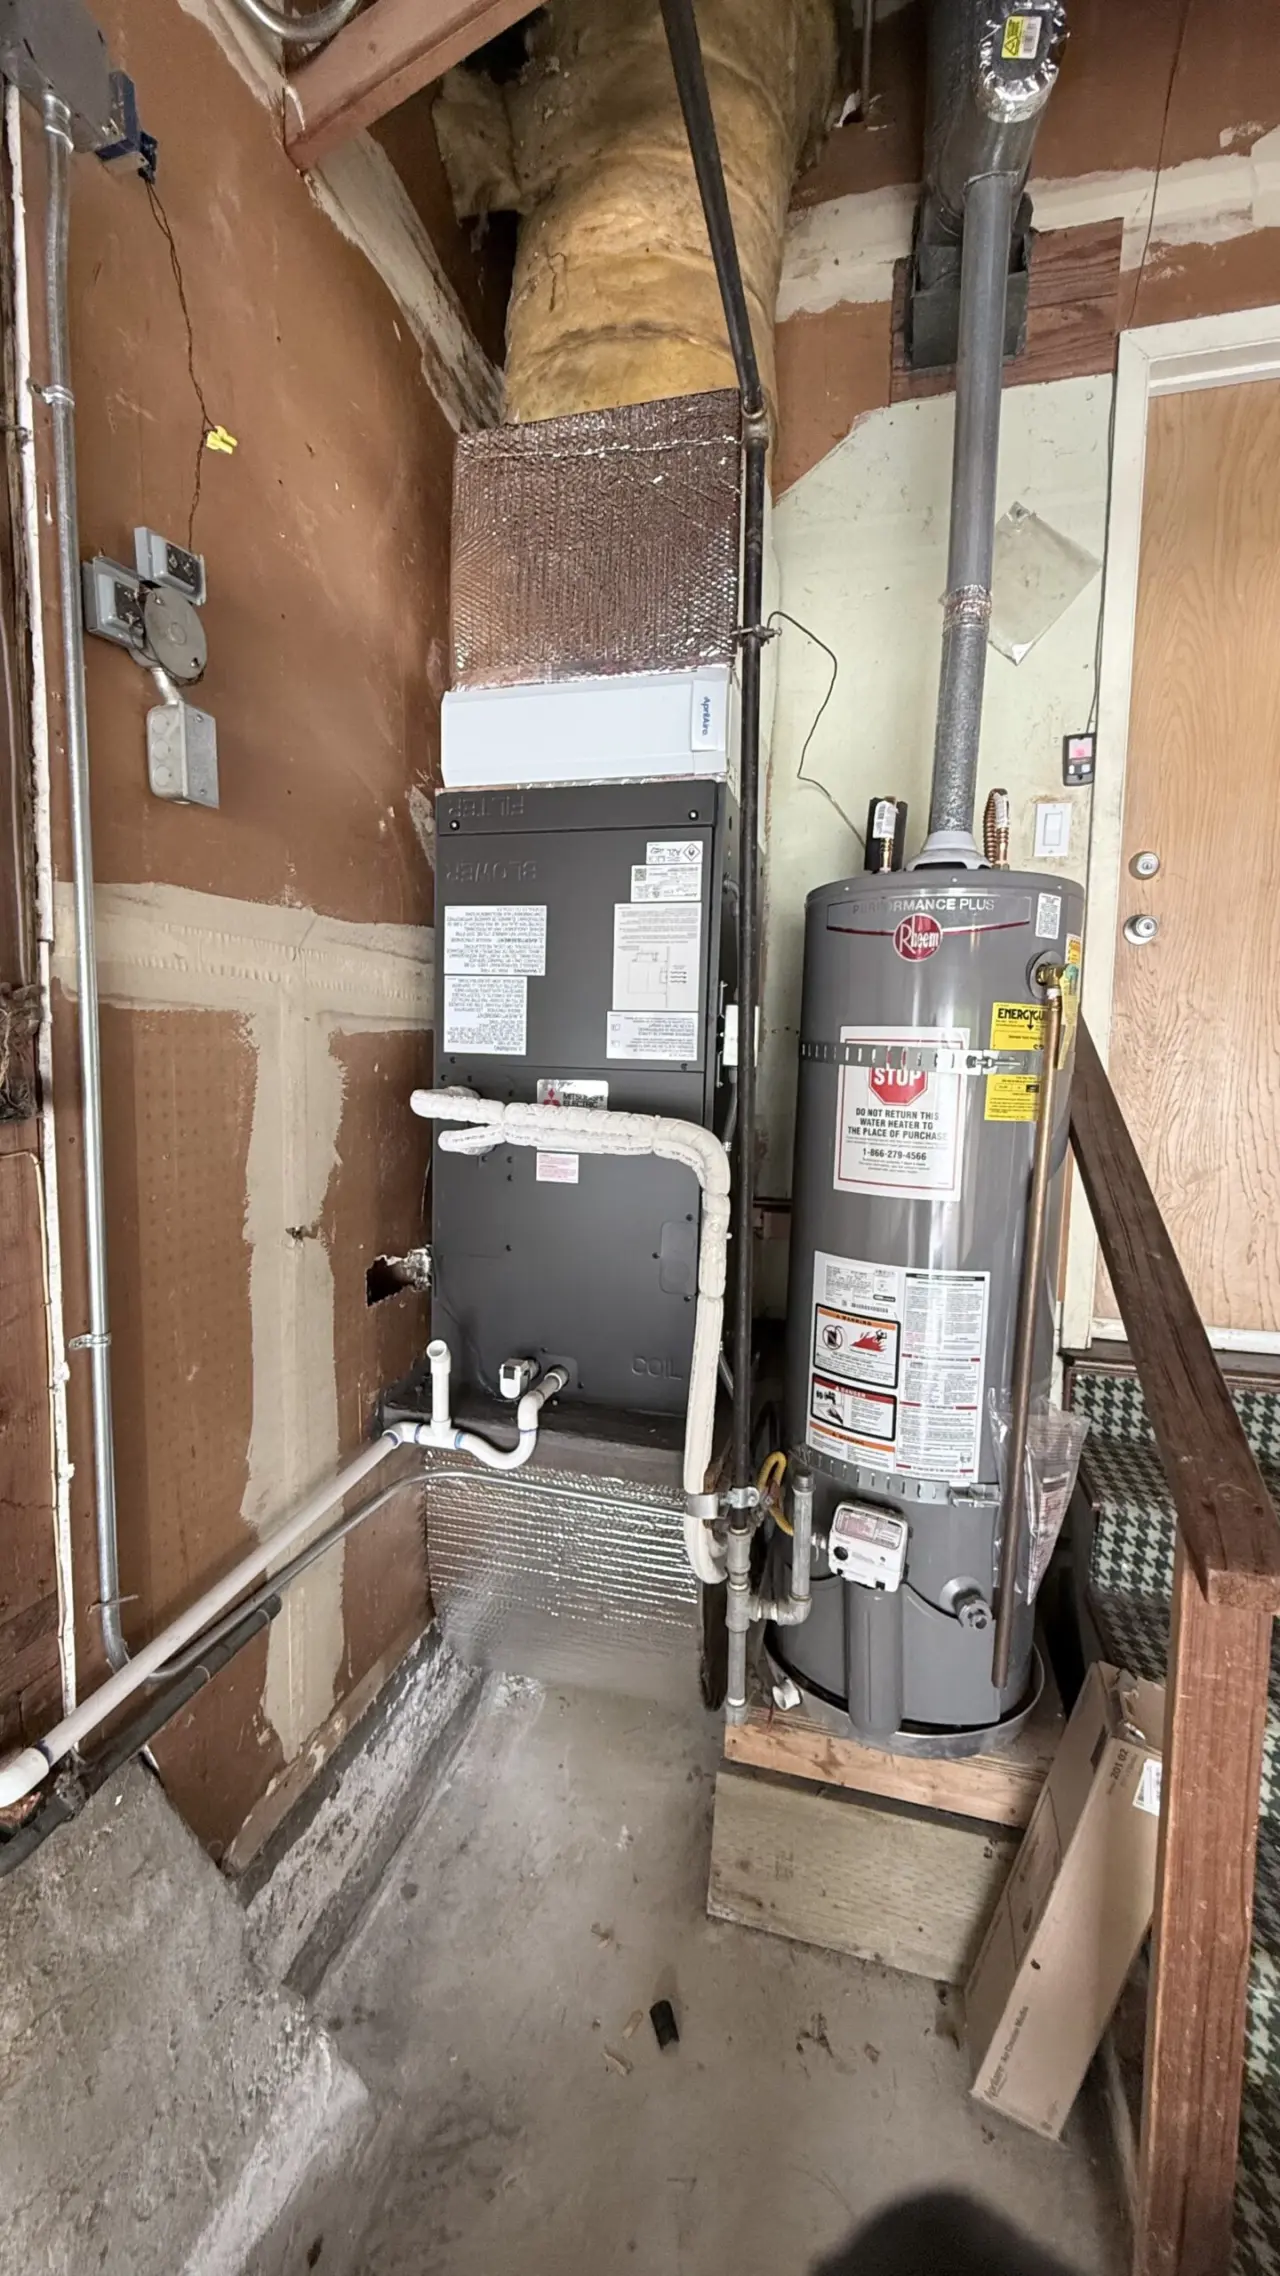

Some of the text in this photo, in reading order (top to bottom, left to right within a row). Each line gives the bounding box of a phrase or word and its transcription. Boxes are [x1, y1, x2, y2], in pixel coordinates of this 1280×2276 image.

[447, 795, 524, 817] FILTER
[443, 860, 537, 883] BLOWER
[959, 898, 995, 911] PLUS
[899, 914, 939, 954] Rheem
[998, 1008, 1044, 1021] ENERGYGU
[873, 1066, 922, 1087] STOP
[855, 1107, 939, 1121] DO NOT RETURN THIS
[860, 1118, 933, 1130] WATER HEATER TO
[847, 1126, 948, 1141] THE PLACE OF PURCHASE
[862, 1147, 927, 1161] 1-866-279-4566
[631, 1356, 684, 1381] COIL
[1110, 1762, 1123, 1780] 201
[1117, 1748, 1128, 1761] 02
